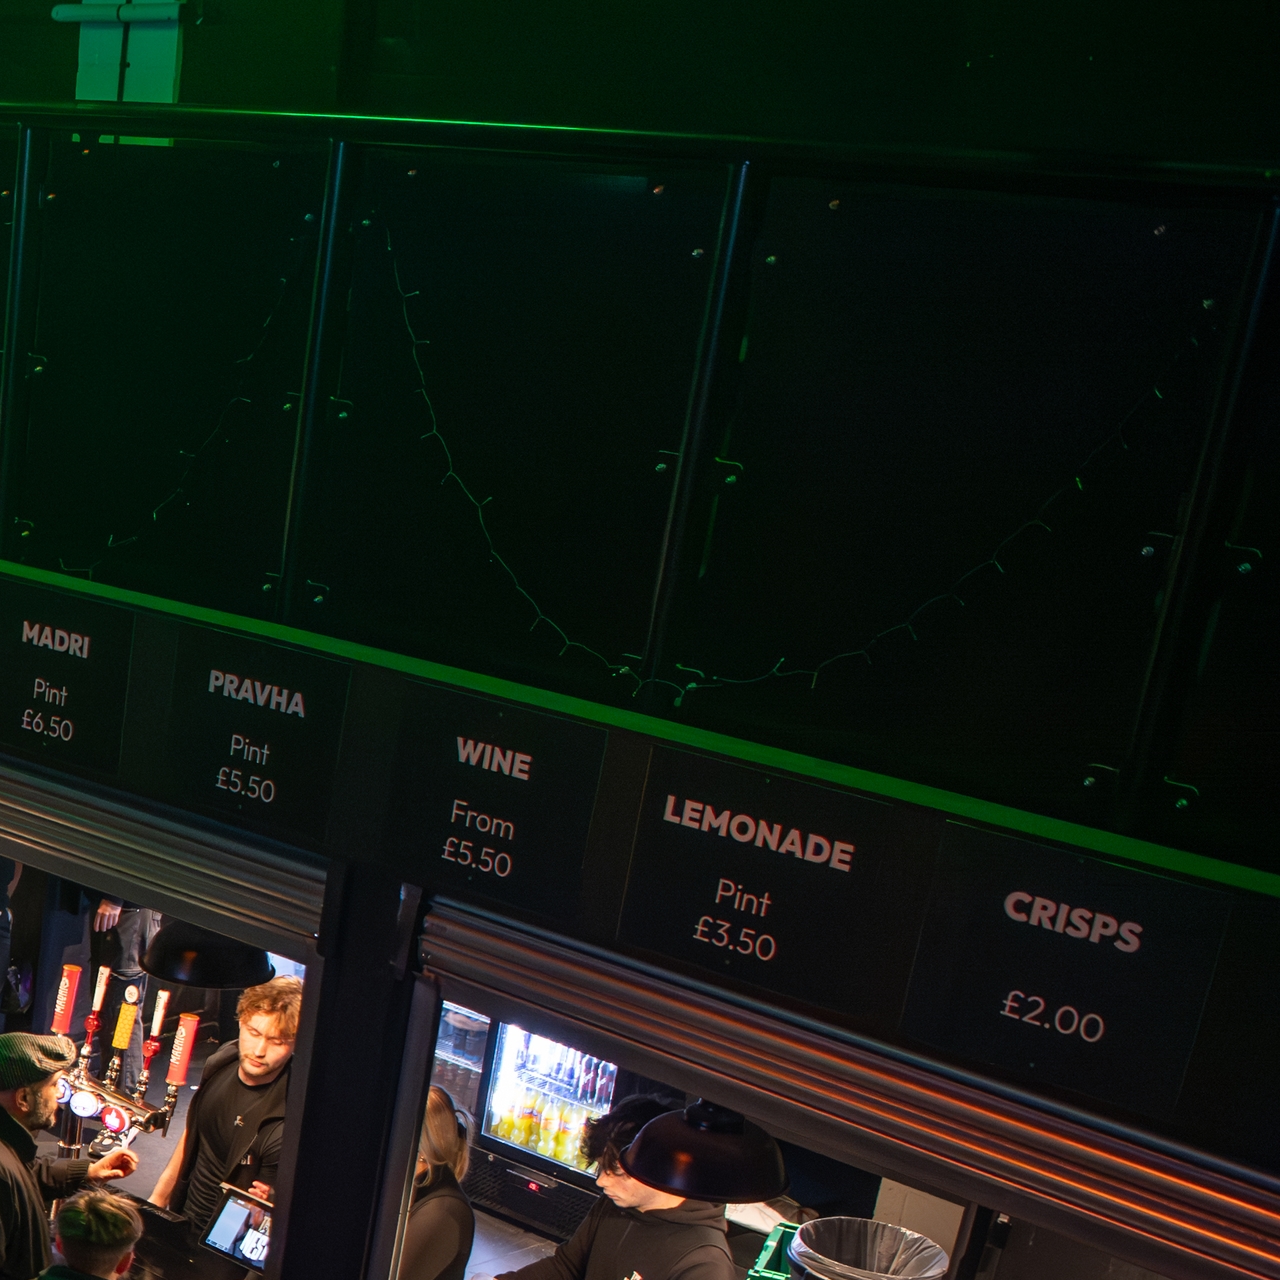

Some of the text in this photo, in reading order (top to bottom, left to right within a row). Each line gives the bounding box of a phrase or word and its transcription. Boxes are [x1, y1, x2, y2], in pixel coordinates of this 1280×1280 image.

[22, 621, 91, 659] MADRI
[33, 678, 69, 707] Pint
[208, 669, 306, 719] PRAVHA
[21, 708, 74, 742] £6.50
[230, 734, 271, 766] Pint
[456, 736, 532, 781] WINE
[216, 766, 276, 803] £5.50
[449, 800, 515, 842] From
[663, 795, 855, 873] LEMONADE
[441, 836, 513, 878] £5.50
[714, 878, 773, 919] Pint
[692, 915, 778, 962] £3.50
[1002, 891, 1143, 954] CRISPS
[999, 990, 1106, 1044] £2.00
